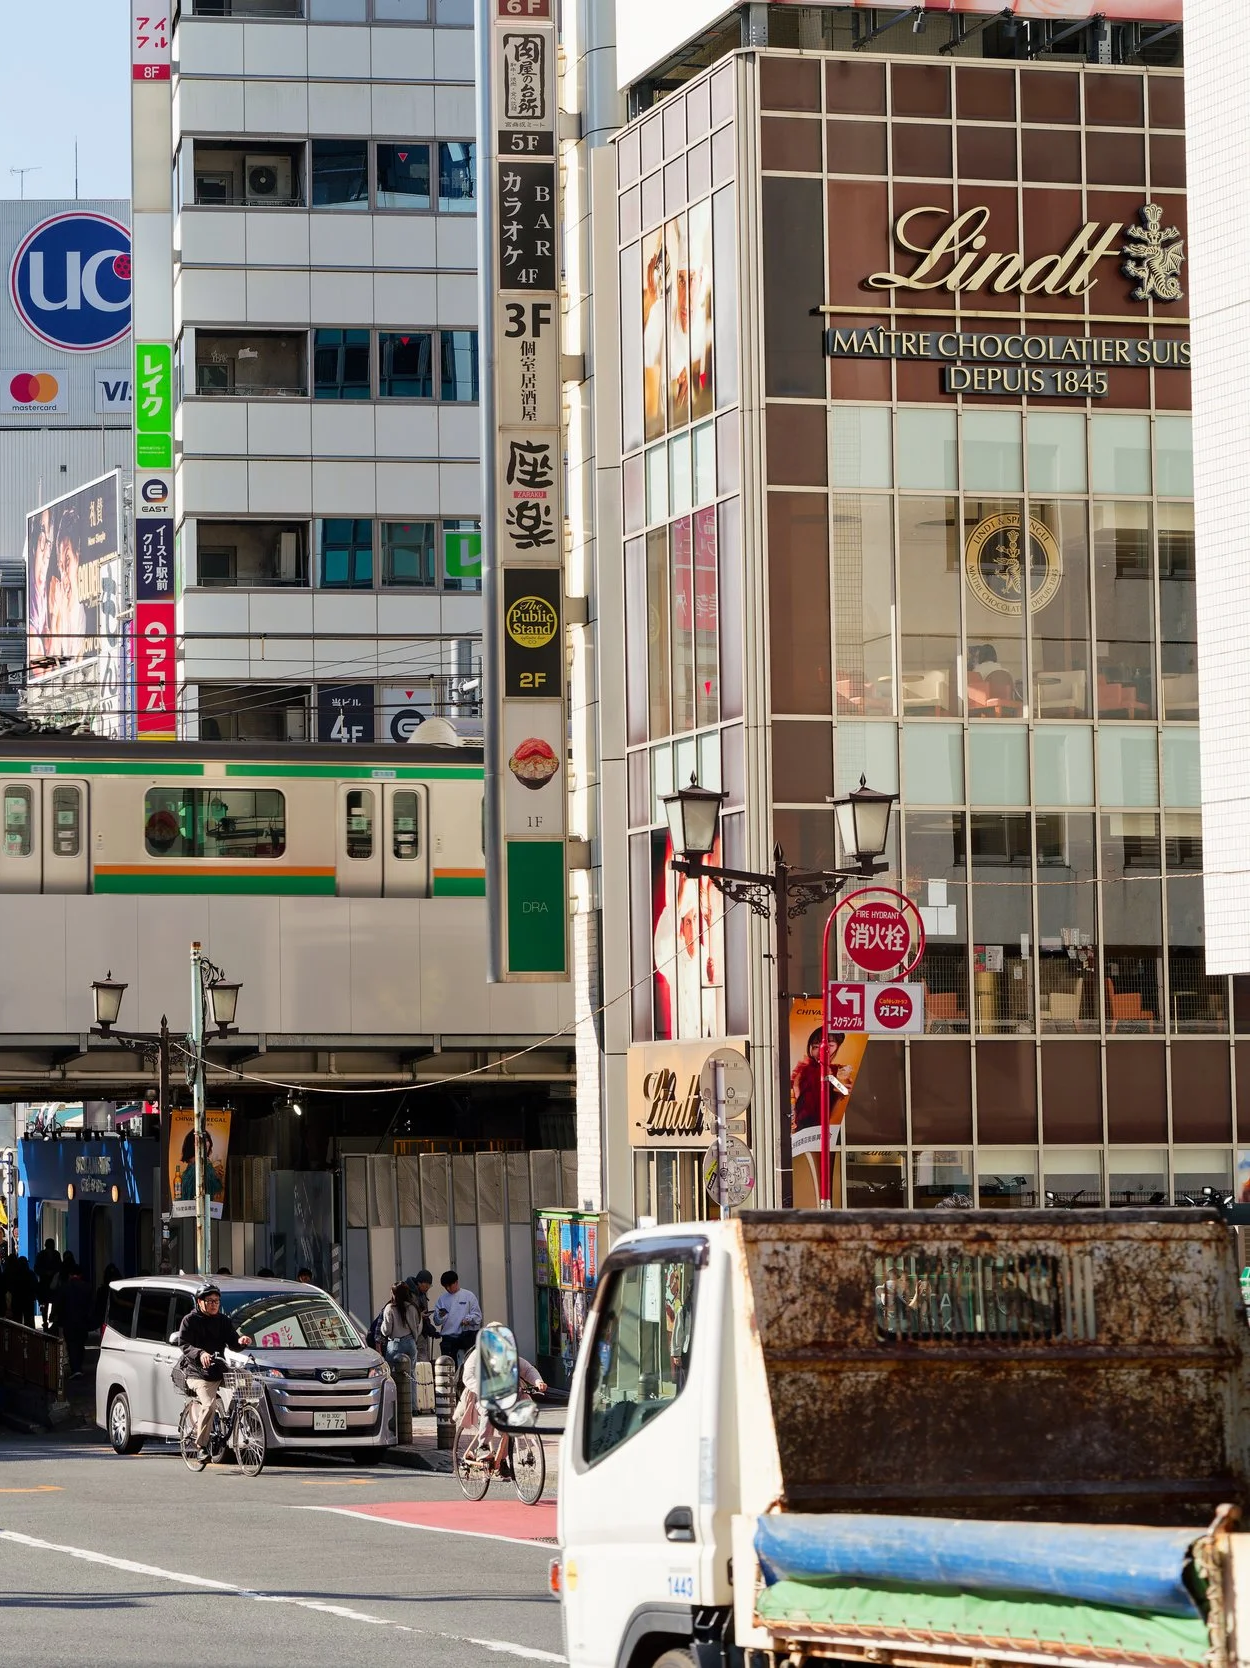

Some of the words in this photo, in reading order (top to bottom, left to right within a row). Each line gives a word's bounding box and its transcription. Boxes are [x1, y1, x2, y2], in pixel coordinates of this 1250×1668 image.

[136, 17, 167, 31] アイ
[136, 36, 168, 48] フル
[144, 66, 160, 78] 8F
[514, 38, 540, 117] 肉屋の台所
[511, 134, 539, 151] 5F
[502, 171, 524, 267] カラオケ
[534, 185, 552, 257] BAR
[868, 206, 1124, 297] Lindt
[517, 268, 539, 284] 4F
[504, 302, 552, 338] 3F
[833, 326, 931, 357] MAÎTRE
[938, 333, 1131, 363] CHOCOLATIER
[142, 355, 163, 417] レイク
[520, 340, 537, 422] 個室居酒屋
[950, 367, 1045, 393] DEPUIS
[1051, 370, 1108, 395] 1845
[102, 381, 132, 401] VI
[518, 490, 544, 499] ZARAKU
[141, 505, 168, 513] EAST
[973, 522, 996, 545] LINDT
[1006, 516, 1050, 542] SPNGLI
[143, 533, 153, 584] クリニック
[156, 524, 168, 591] イースト駅前
[519, 600, 543, 610] The
[981, 592, 1022, 612] CHOCOLAT
[512, 609, 554, 622] Public
[513, 622, 551, 634] Stand
[520, 672, 547, 688] 2F
[331, 697, 362, 707] 当ビル
[330, 714, 363, 743] 4F
[527, 816, 543, 828] 1F
[523, 902, 549, 914] DRA
[855, 910, 870, 919] FIRE
[871, 911, 901, 920] HYDRANT
[850, 922, 906, 951] 消火栓
[879, 1005, 909, 1017] ガスト
[833, 1016, 863, 1028] スクランブル
[668, 1576, 693, 1597] 1443
